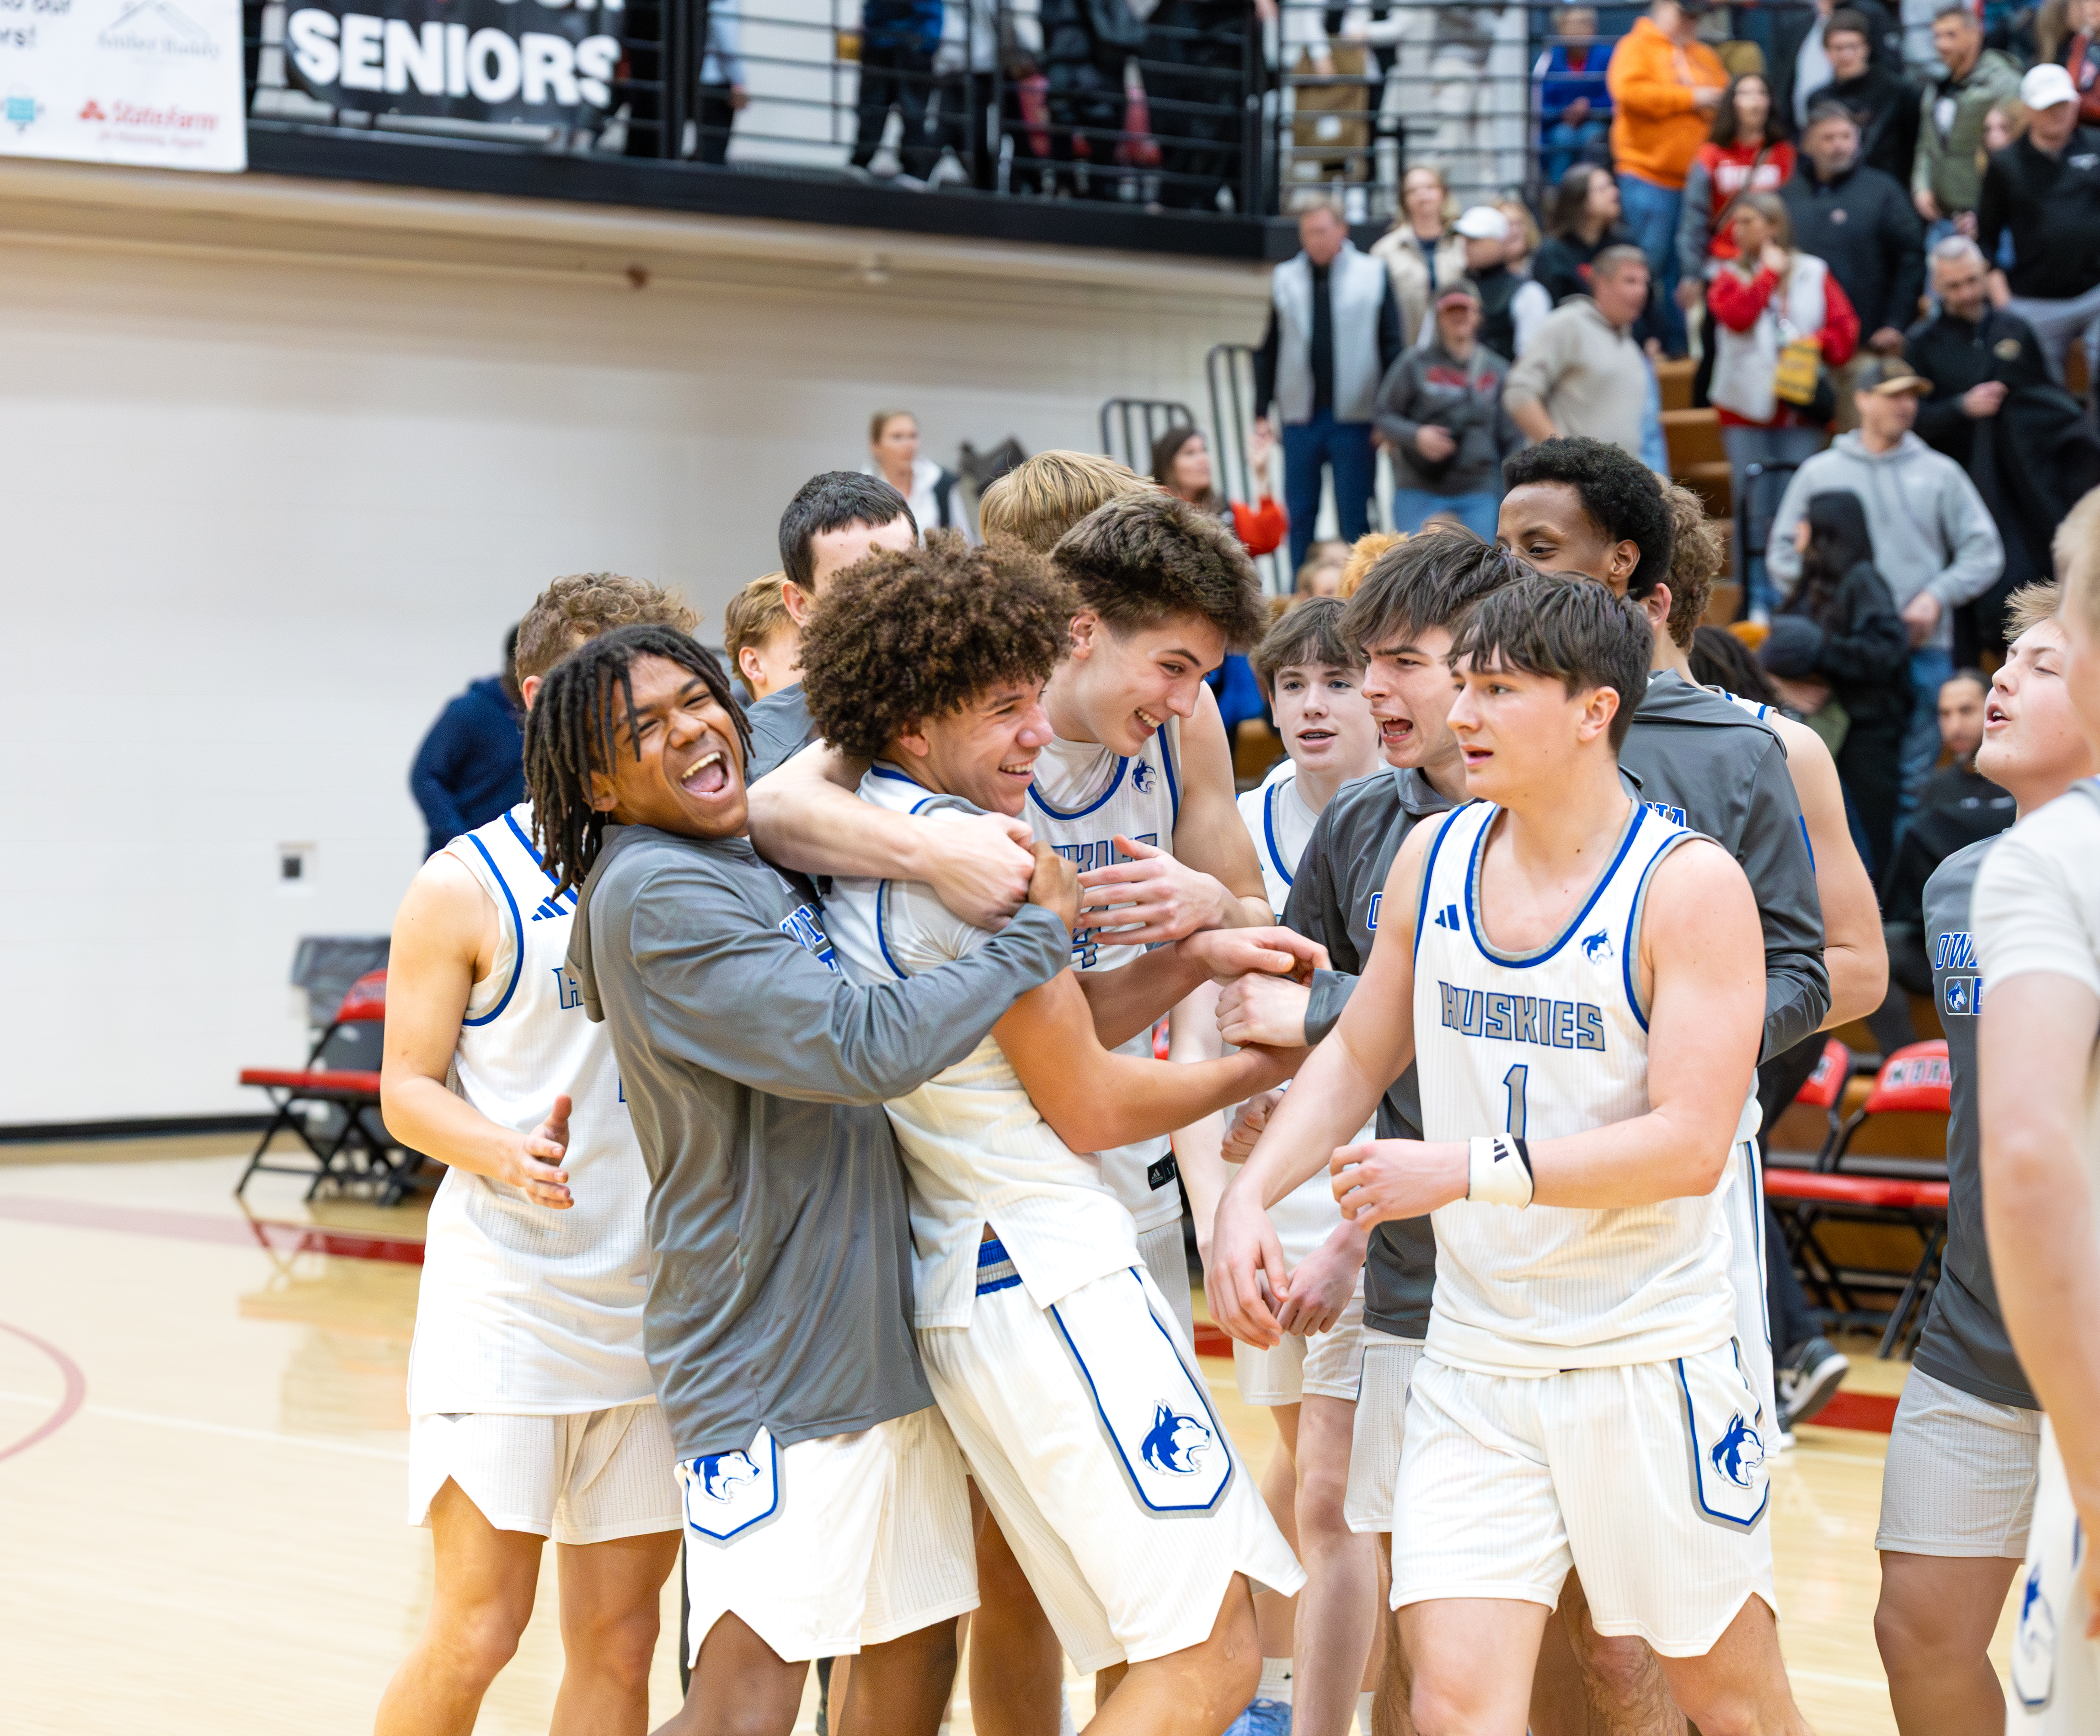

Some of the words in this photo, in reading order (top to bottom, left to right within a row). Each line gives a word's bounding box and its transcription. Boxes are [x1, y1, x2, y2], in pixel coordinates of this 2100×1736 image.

[288, 8, 621, 108] SENIORS
[1437, 980, 1605, 1052] HUSKIES
[1503, 1063, 1528, 1139] 1
